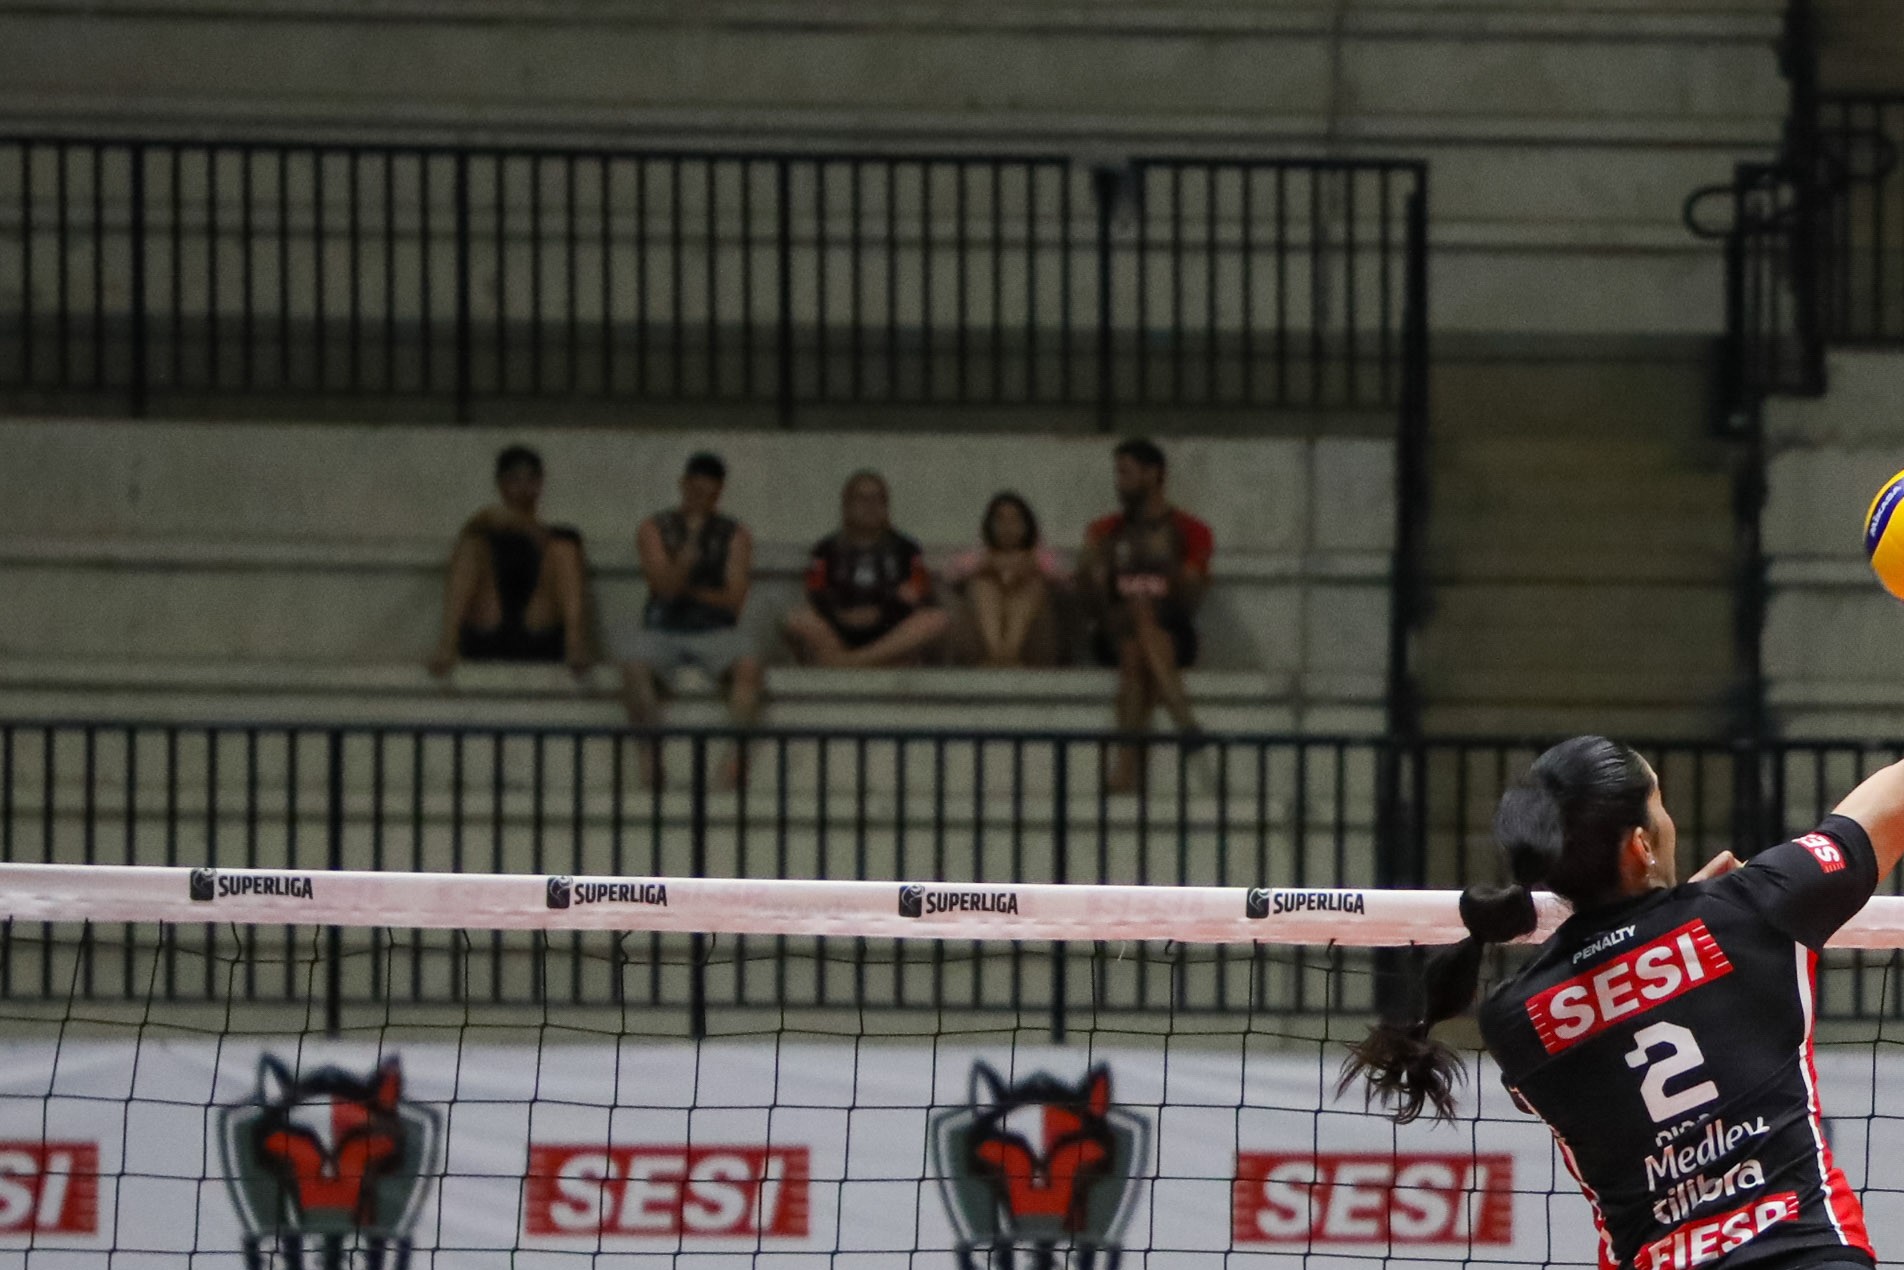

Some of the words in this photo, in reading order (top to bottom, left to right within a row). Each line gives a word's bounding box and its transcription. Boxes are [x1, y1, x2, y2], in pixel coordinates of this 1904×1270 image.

[1792, 833, 1840, 863] SE
[217, 875, 313, 899] SUPERLIGA
[574, 883, 668, 906] SUPERLIGA
[926, 891, 1019, 915] SUPERLIGA
[1272, 891, 1365, 915] SUPERLIGA
[1573, 925, 1636, 965] PENALTY
[1549, 932, 1704, 1041] SESI
[1625, 1021, 1719, 1123] 2
[550, 1154, 785, 1230] SESI
[1255, 1163, 1487, 1238] SESI
